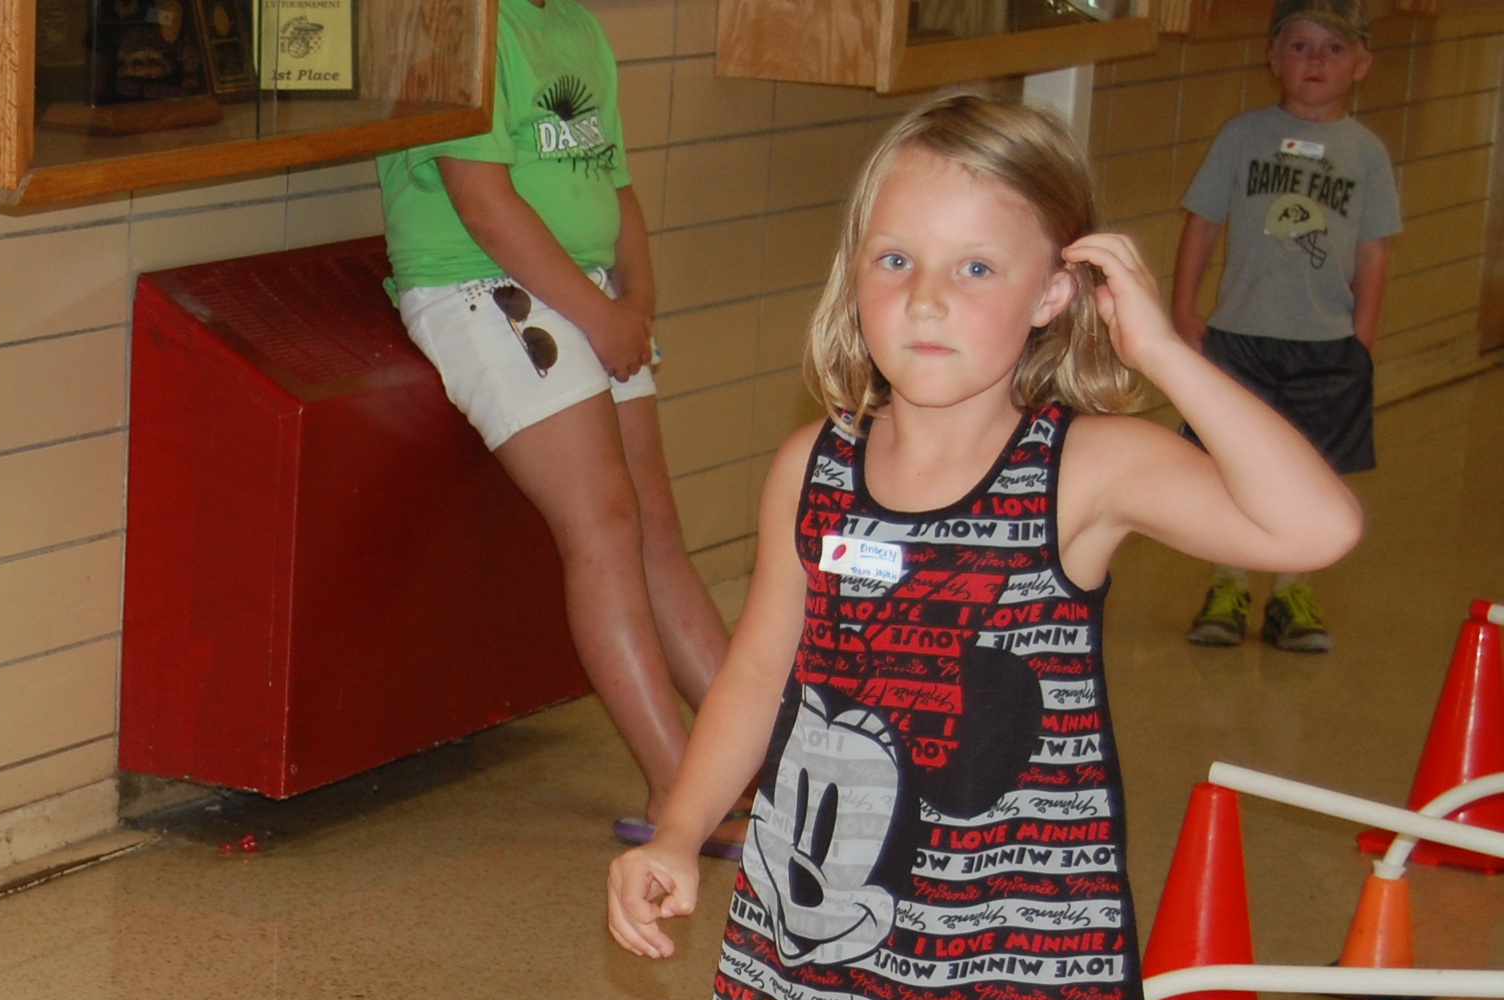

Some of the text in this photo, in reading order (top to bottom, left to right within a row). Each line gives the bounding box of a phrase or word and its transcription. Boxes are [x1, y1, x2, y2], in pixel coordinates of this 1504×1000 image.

[270, 69, 340, 81] 1st Place
[1246, 159, 1303, 196] GAME
[1307, 172, 1356, 217] FACE
[993, 627, 1079, 650] MINNIE
[1041, 711, 1101, 734] MINNI
[1028, 792, 1099, 817] Minnie
[930, 821, 1112, 850] I LOVE MINNIE
[960, 846, 1053, 875] MINNIE
[913, 875, 982, 904] Minnie
[987, 874, 1060, 898] Minnie
[937, 903, 1008, 930] Minnie
[1015, 902, 1092, 927] Minnie
[913, 930, 1105, 958] I LOVE MINNIE
[946, 955, 1044, 980] MINNIE
[1053, 956, 1115, 979] LOVE
